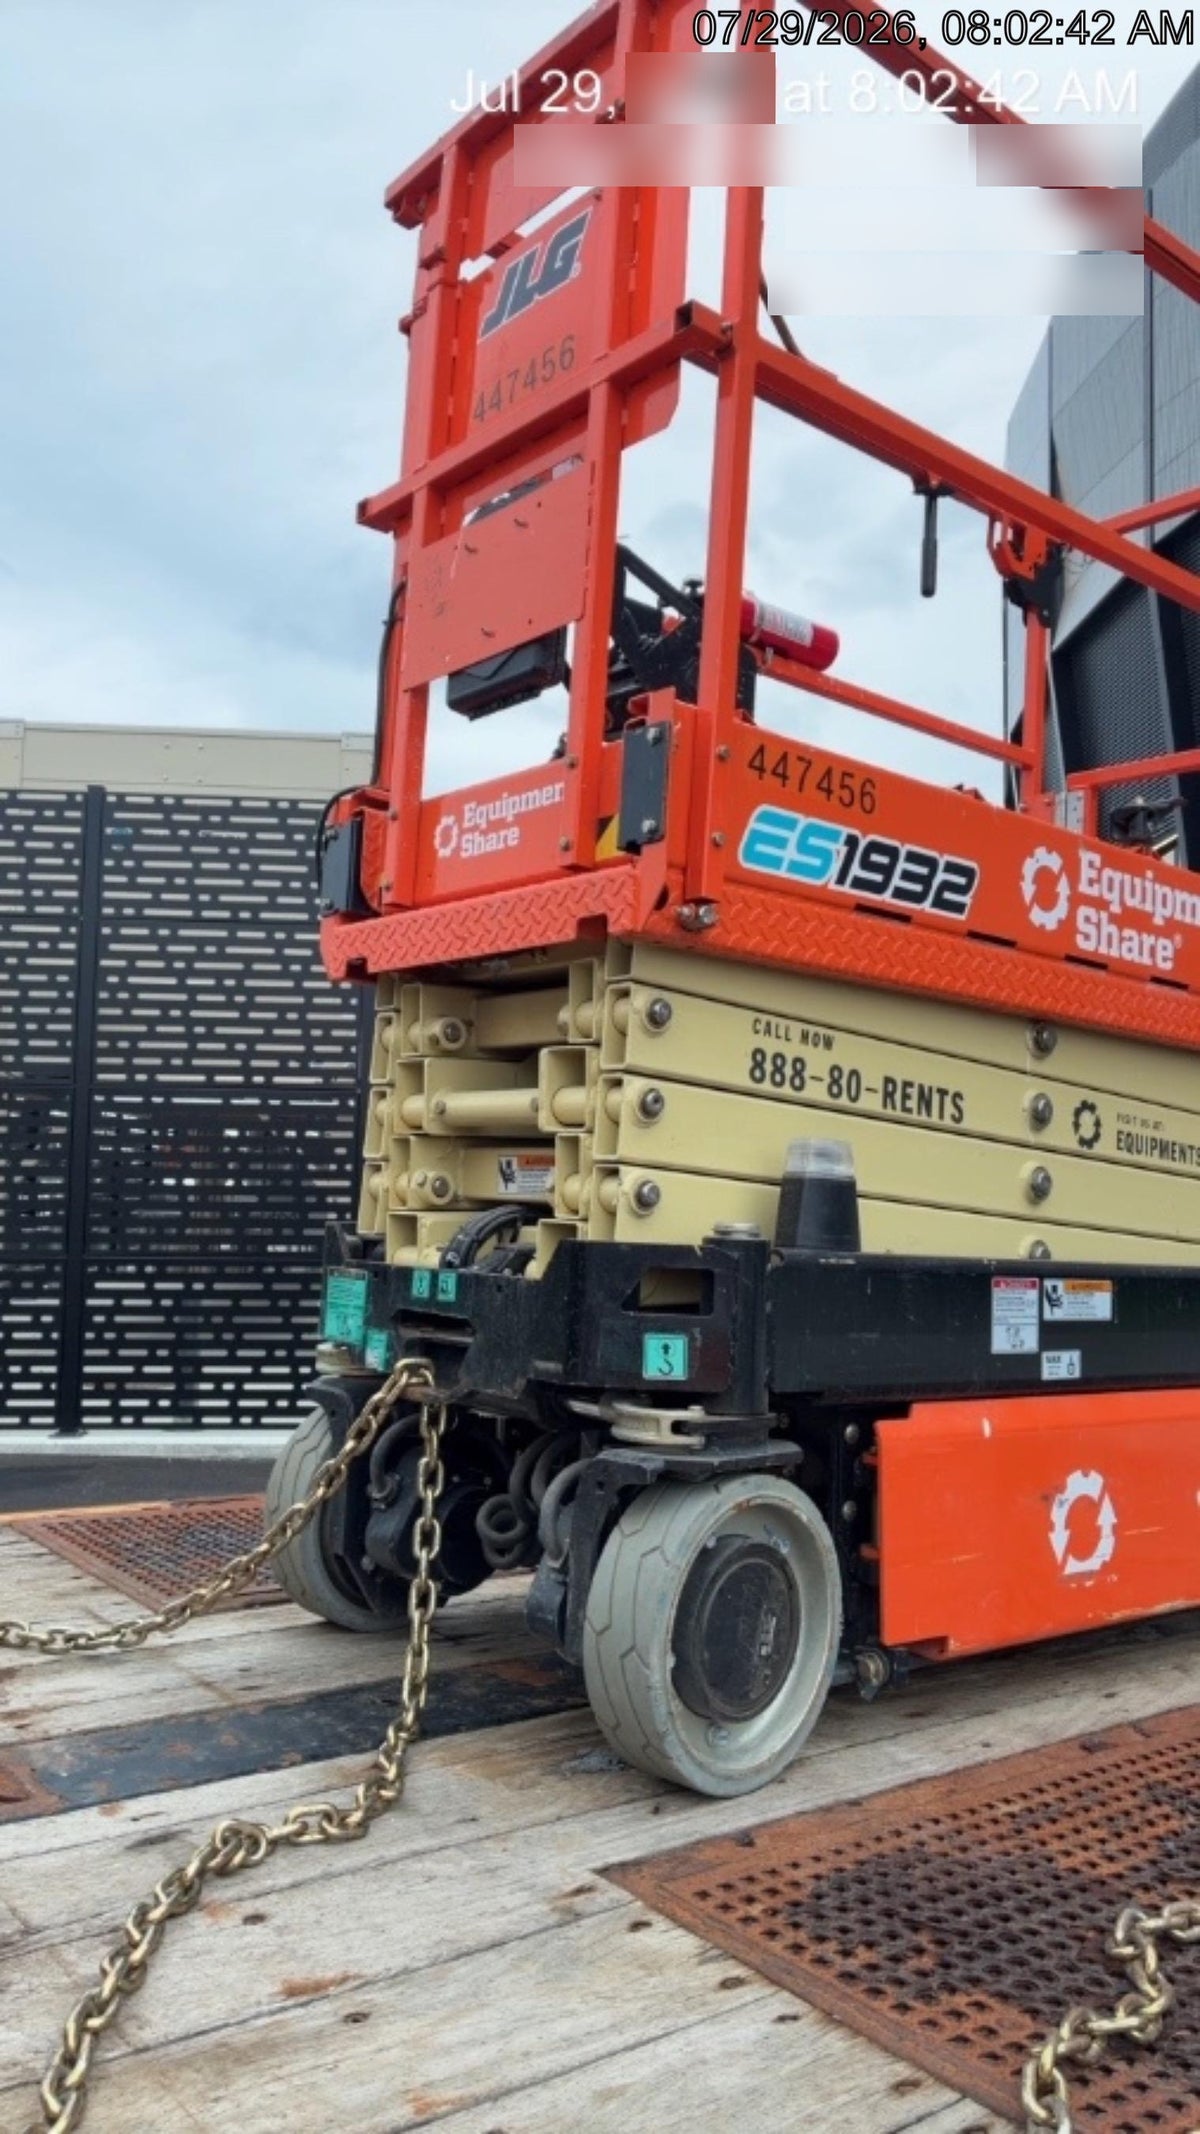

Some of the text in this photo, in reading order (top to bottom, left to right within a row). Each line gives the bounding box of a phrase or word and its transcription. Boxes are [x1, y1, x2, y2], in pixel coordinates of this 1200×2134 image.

[478, 205, 593, 344] JLG
[472, 333, 576, 423] 447456
[747, 743, 877, 815] 447456
[459, 825, 520, 858] Share
[738, 803, 980, 921] ES1932
[752, 1017, 835, 1051] CALL NOW
[749, 1047, 964, 1125] 888-80-RENTS
